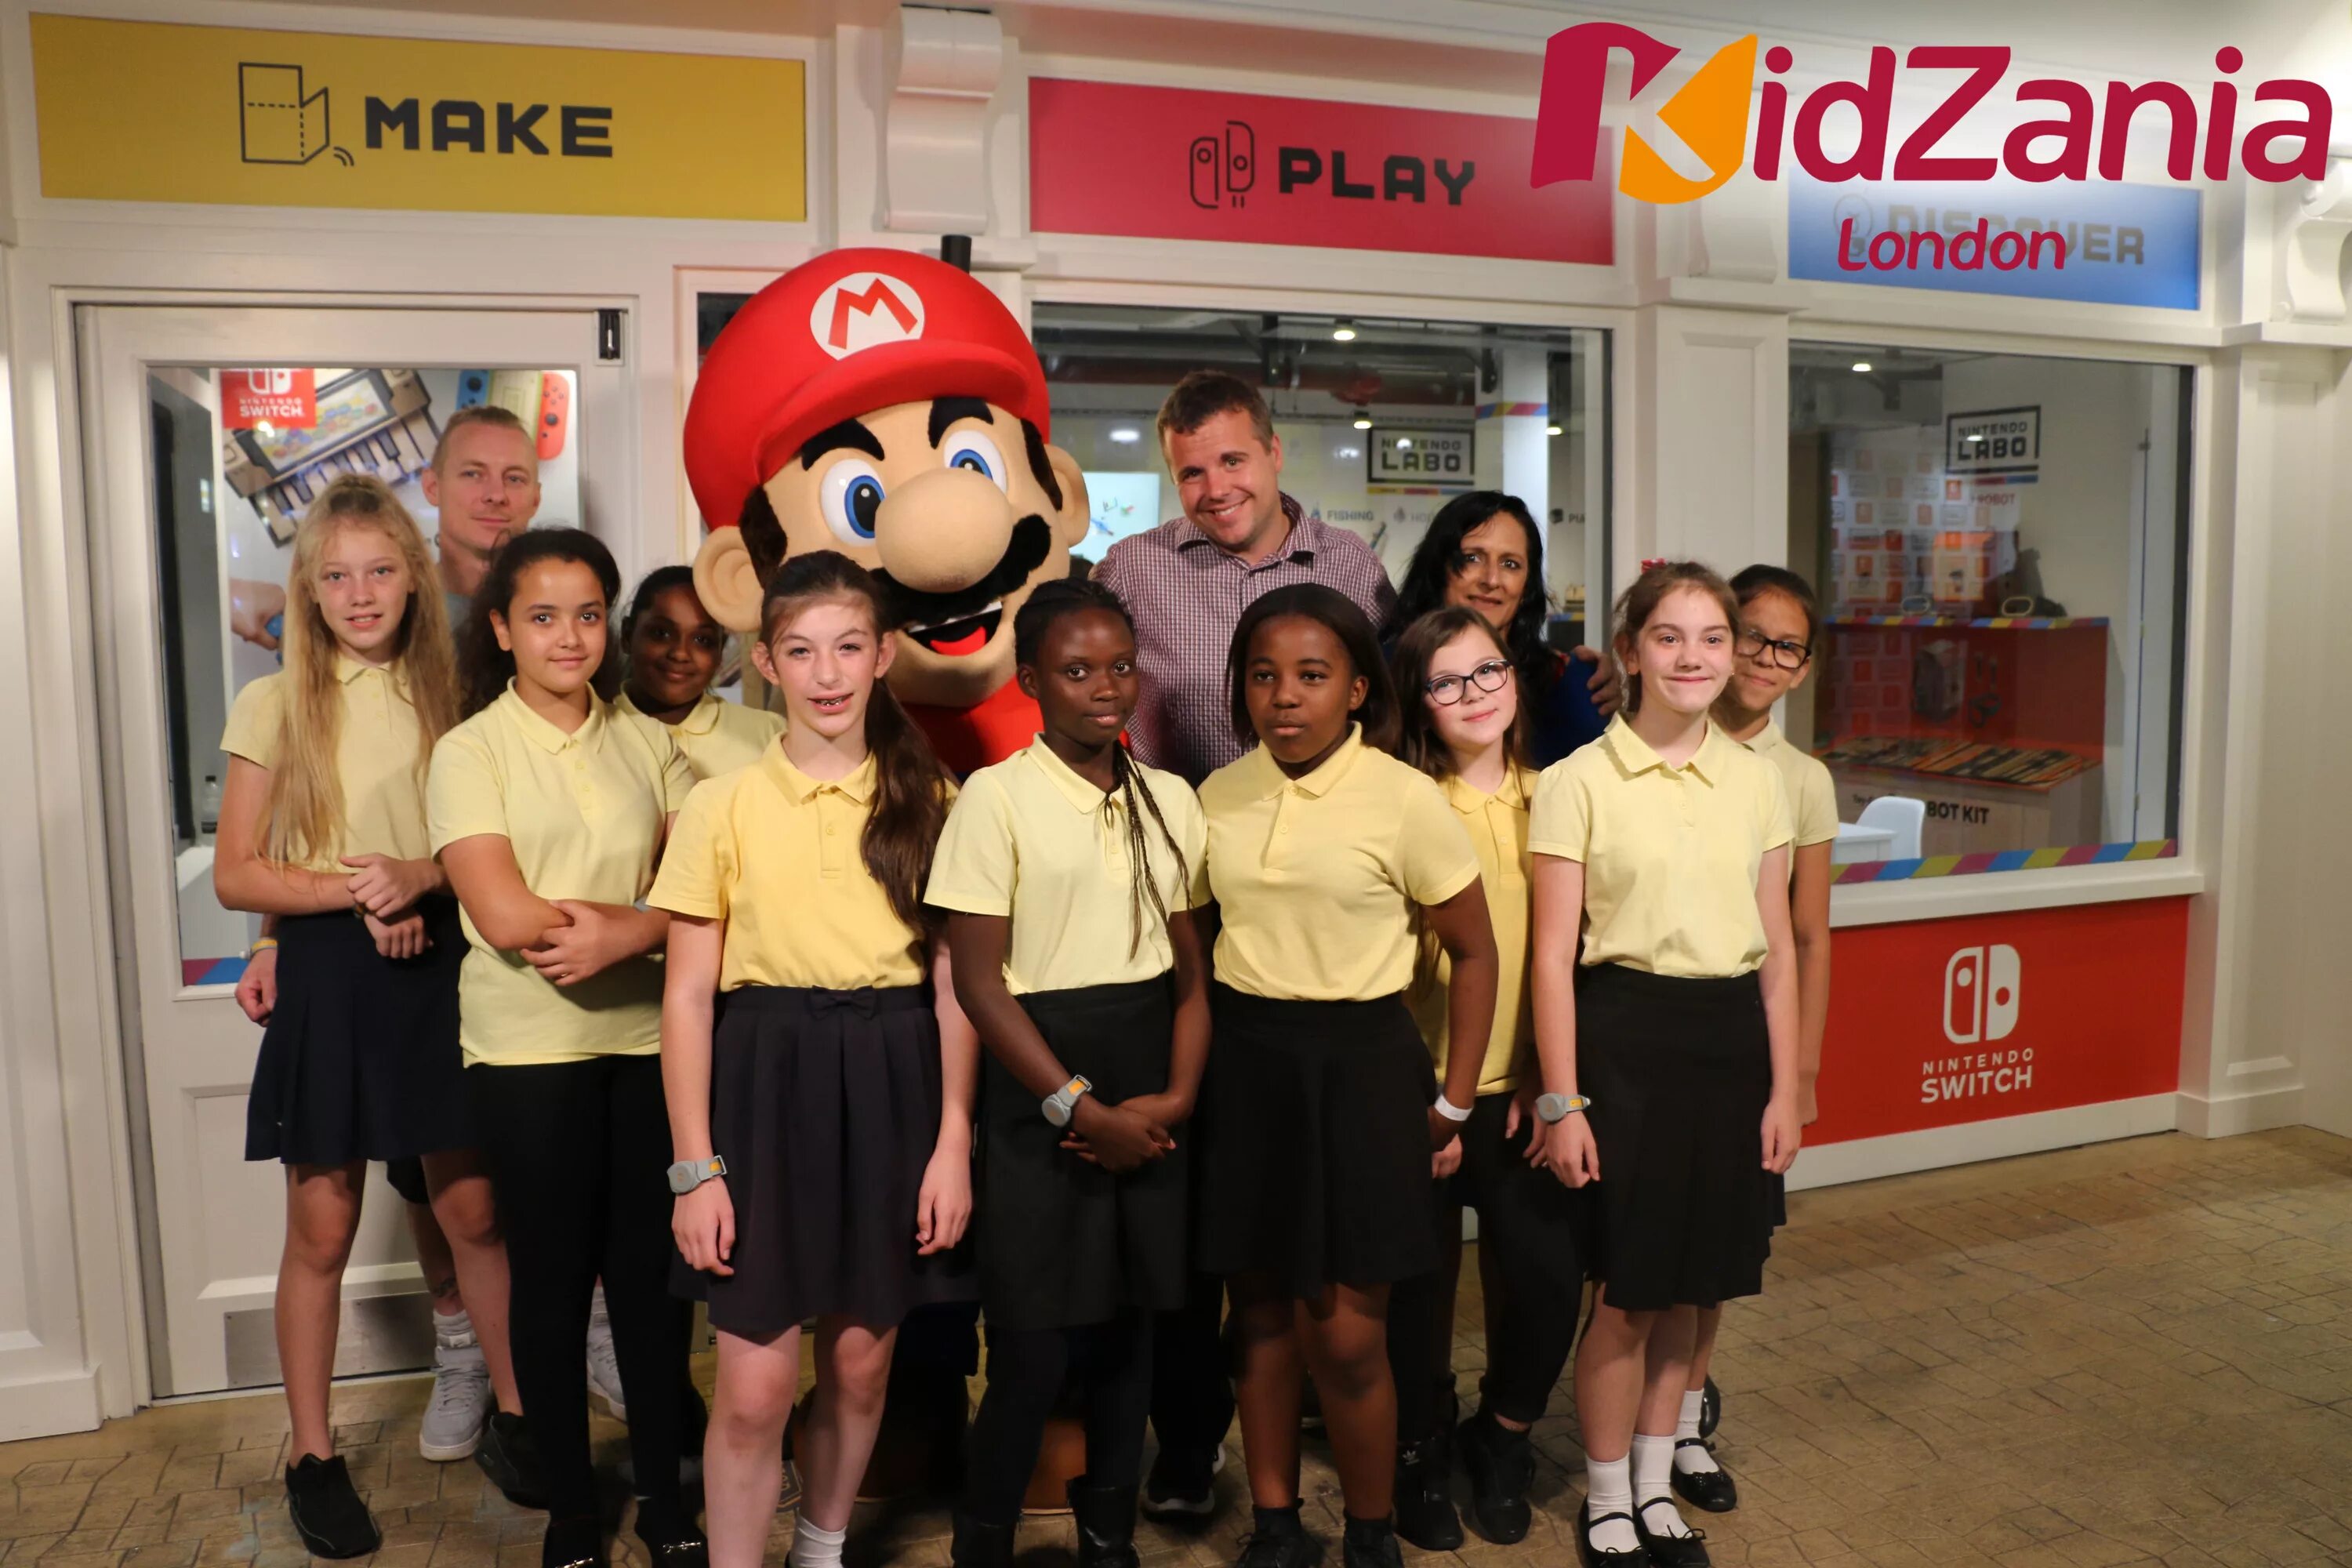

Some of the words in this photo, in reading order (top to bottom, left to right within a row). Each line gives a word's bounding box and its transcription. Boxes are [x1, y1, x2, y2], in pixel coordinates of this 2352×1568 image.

[365, 96, 613, 158] MAKE
[1279, 147, 1475, 205] PLAY
[1888, 204, 2145, 265] DISCOVER
[828, 278, 918, 350] M
[239, 405, 303, 418] SWITCH
[1381, 437, 1461, 451] NITENDO
[1958, 436, 2027, 461] LABO
[1381, 451, 1461, 472] LABO
[1327, 510, 1374, 521] FISHING
[1926, 800, 1959, 820] BOT
[1962, 804, 1990, 825] KIT
[1922, 1047, 2034, 1076] NINTENDO
[1921, 1065, 2033, 1104] SWITCH
